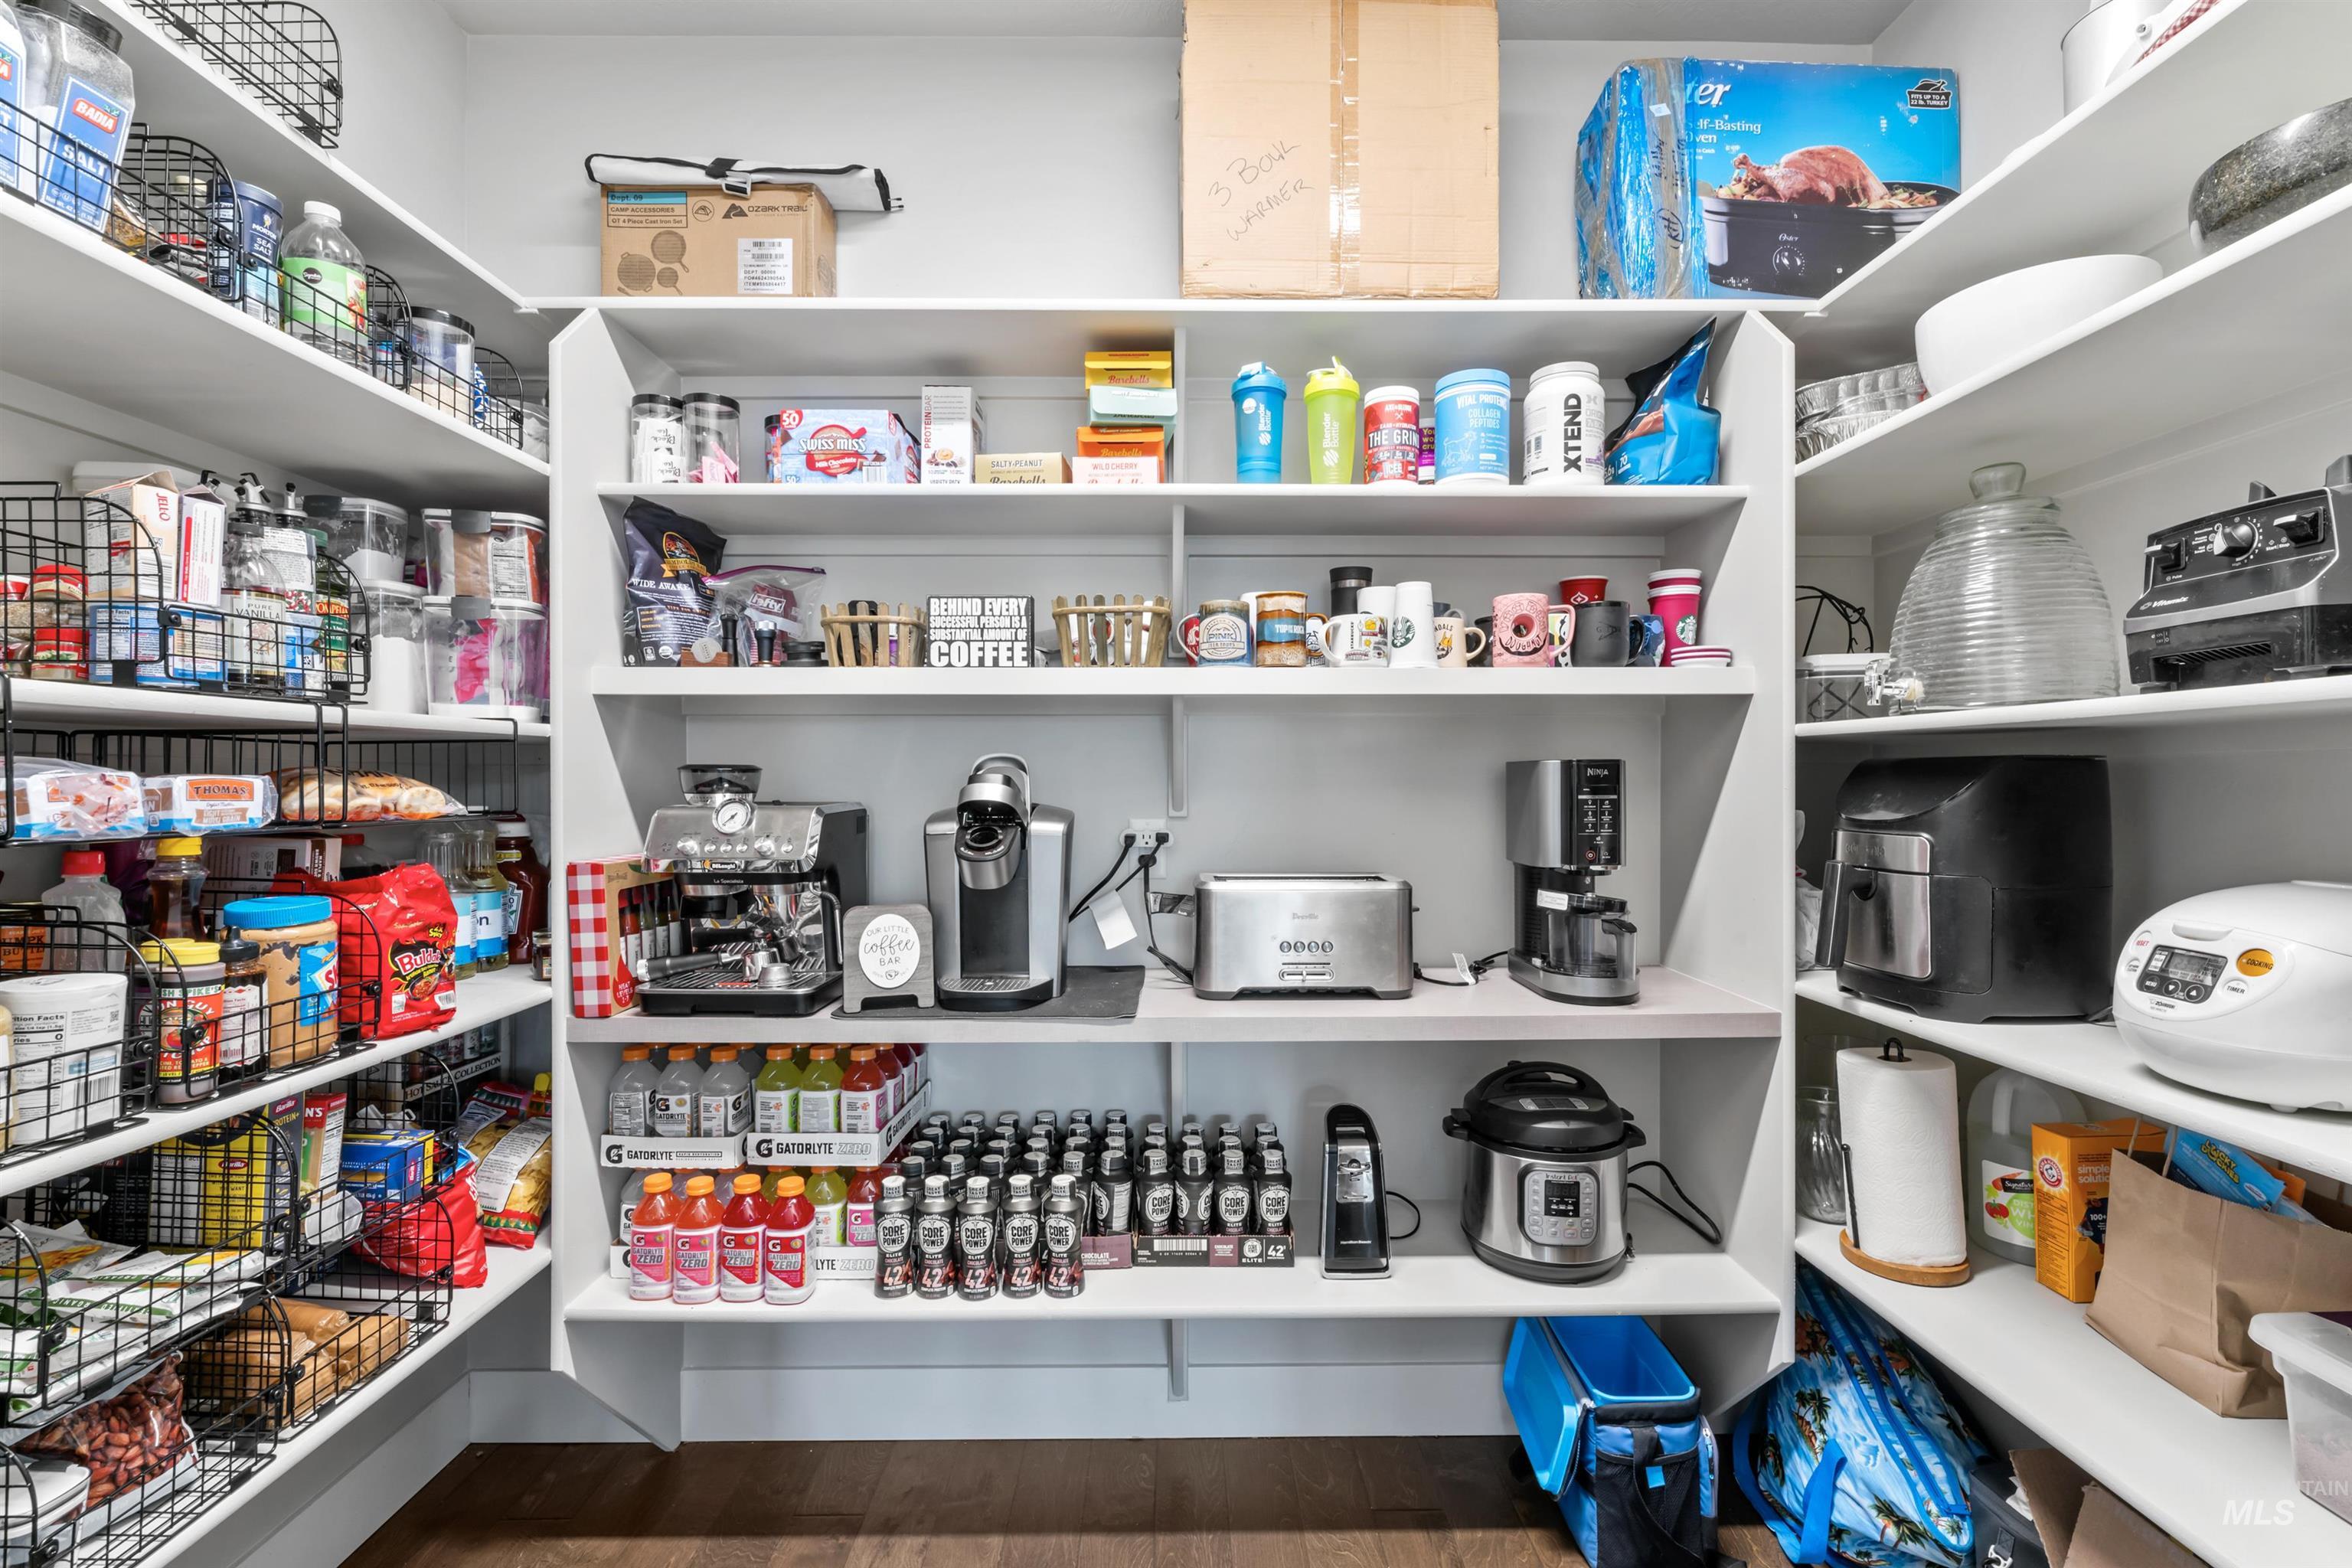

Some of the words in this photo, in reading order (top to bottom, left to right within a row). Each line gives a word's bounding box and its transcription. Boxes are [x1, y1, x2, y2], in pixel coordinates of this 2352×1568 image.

[76, 101, 116, 130] BADIA
[62, 145, 108, 174] SALT
[1208, 181, 1231, 207] 3
[1227, 139, 1302, 185] BOWL
[611, 194, 631, 203] Dept.
[747, 204, 780, 213] OZARK
[781, 204, 808, 213] TRAIL
[1227, 178, 1315, 241] WARMER
[253, 224, 277, 240] MORTON
[256, 237, 272, 249] SEA
[253, 243, 272, 256] SALT
[1108, 375, 1149, 384] Barebells
[1456, 395, 1476, 409] VITAL
[1479, 394, 1508, 410] PROTEINS
[782, 413, 799, 425] 50
[1468, 409, 1501, 418] COLLAGEN
[1322, 412, 1331, 448] Blender
[1469, 420, 1500, 429] PEPTIDES
[1369, 430, 1389, 447] THE
[1563, 393, 1582, 473] XTEND
[799, 438, 834, 452] SWISS
[1101, 449, 1142, 457] Barebells
[828, 458, 857, 466] Chocolate
[156, 492, 171, 521] JELL-O
[632, 579, 655, 588] WIDE
[658, 582, 691, 590] AWAKE
[929, 598, 982, 616] BEHIND
[985, 598, 1027, 616] EVERY
[2152, 596, 2188, 608] Vitamix
[236, 608, 280, 619] VANILLA
[929, 616, 979, 629] SUCCESSFUL
[980, 616, 1011, 629] PERSON
[1012, 616, 1020, 628] IS
[1021, 616, 1027, 628] A
[929, 629, 982, 641] SUBSTANTIAL
[983, 629, 1018, 641] AMOUNT
[1018, 629, 1027, 641] OF
[1505, 635, 1542, 650] DOUGHNUT
[929, 641, 1028, 667] COFFEE
[1587, 768, 1609, 777] NINJA
[867, 927, 881, 936] OUR
[864, 934, 915, 956] coffee
[395, 949, 442, 975] Buldak
[880, 956, 900, 966] BAR
[2246, 958, 2273, 970] COOKING
[619, 982, 632, 991] HEAT
[2226, 985, 2246, 995] TIMER
[617, 988, 634, 998] LEVELS
[455, 1056, 501, 1080] COLLECTION
[276, 1099, 296, 1113] Barilla
[606, 1144, 623, 1163] G
[627, 1150, 673, 1161] GATORLYTE
[756, 1138, 773, 1158] G
[776, 1142, 834, 1155] GATORLYTE
[837, 1142, 871, 1155] ZERO
[2078, 1165, 2109, 1174] simple
[1152, 1194, 1171, 1208] CORE
[1225, 1197, 1245, 1207] CORE
[1266, 1196, 1285, 1207] CORE
[1152, 1207, 1170, 1215] POWER
[1266, 1207, 1285, 1215] POWER
[883, 1224, 904, 1236] CORE
[922, 1226, 944, 1238] CORE
[965, 1227, 987, 1239] CORE
[1011, 1224, 1033, 1237] CORE
[1049, 1225, 1069, 1237] CORE
[883, 1236, 904, 1246] POWER
[923, 1238, 944, 1247] POWER
[965, 1238, 987, 1247] POWER
[1011, 1236, 1032, 1246] POWER
[1050, 1237, 1069, 1246] POWER
[637, 1255, 663, 1263] ZERO
[681, 1259, 707, 1268] ZERO
[727, 1256, 753, 1266] ZERO
[773, 1261, 800, 1269] ZERO
[840, 1259, 874, 1270] ZERO
